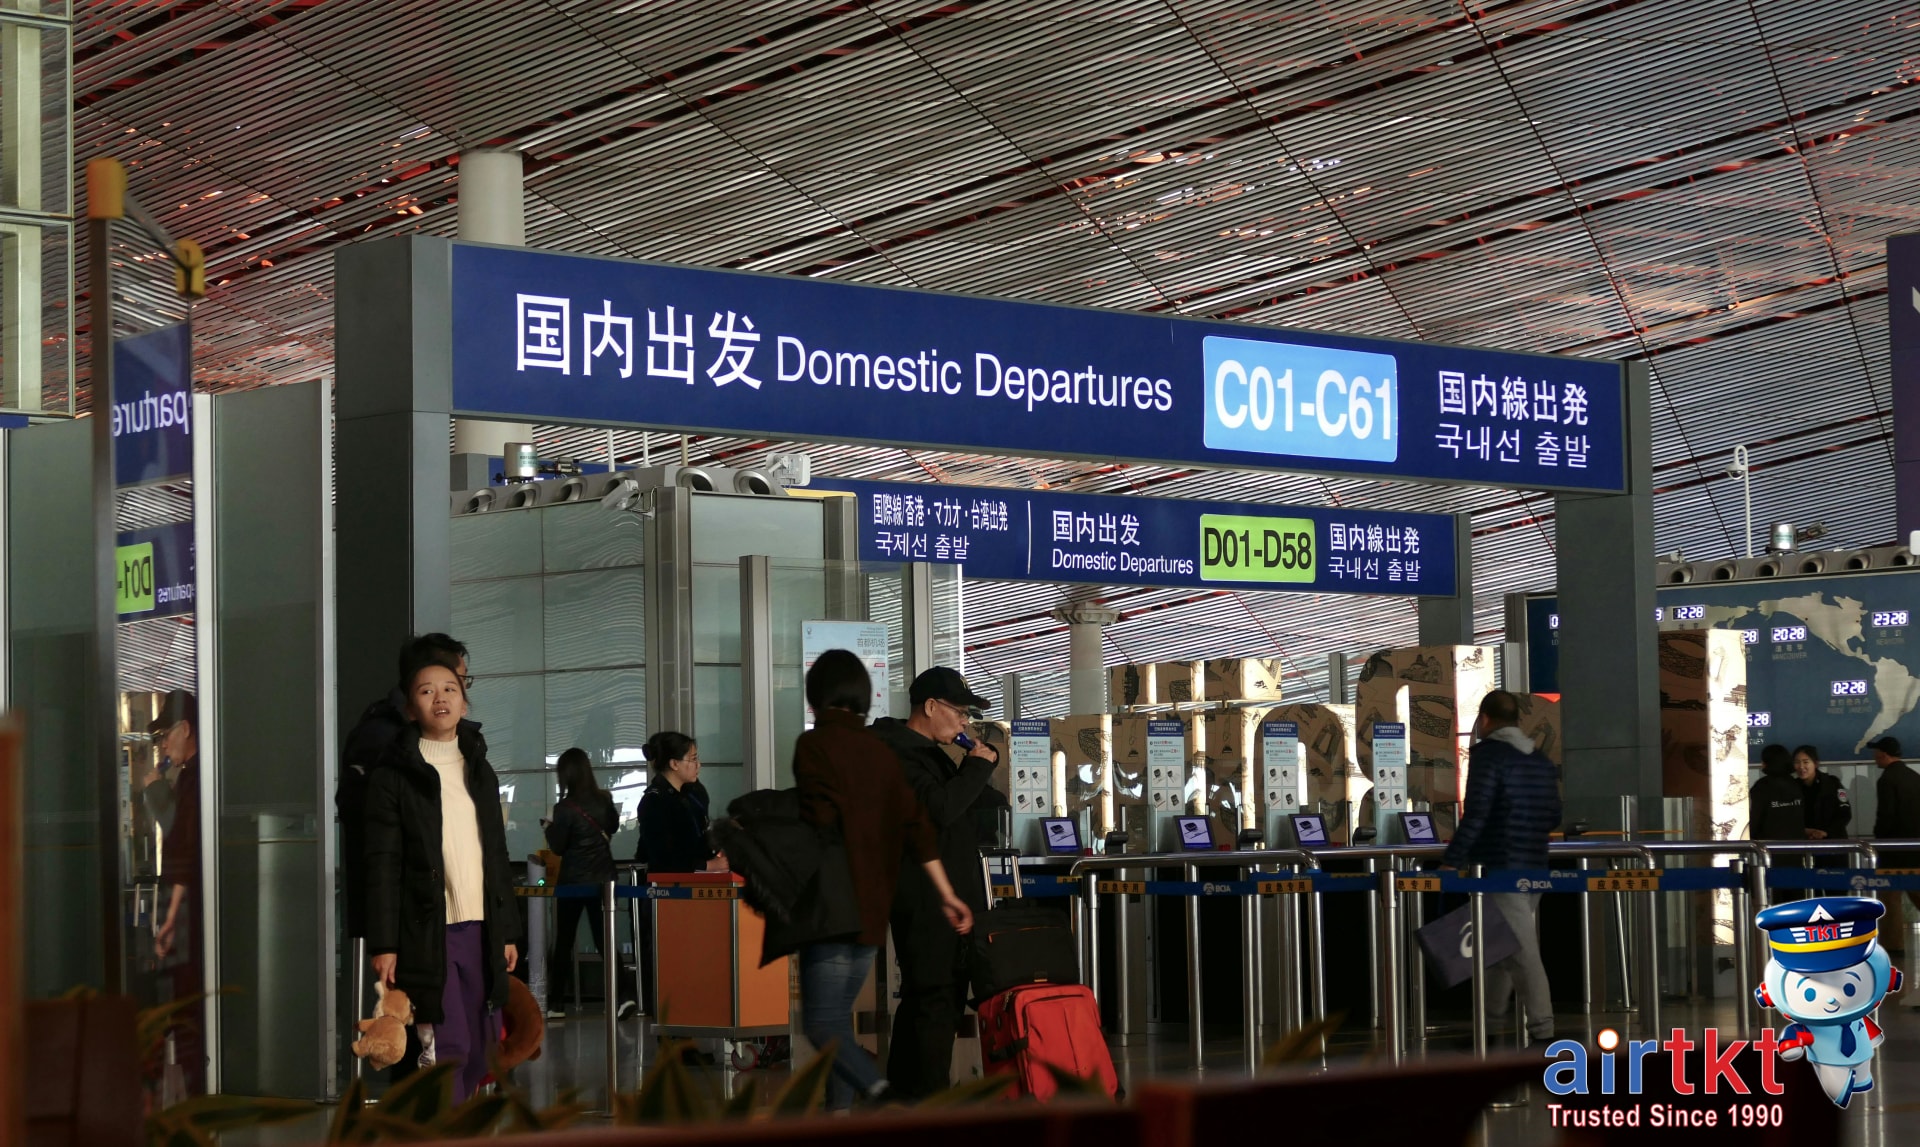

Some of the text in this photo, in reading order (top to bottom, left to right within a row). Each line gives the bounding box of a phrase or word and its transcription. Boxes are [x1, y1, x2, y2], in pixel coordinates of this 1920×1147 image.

[515, 293, 763, 390] 国内出发
[777, 335, 1174, 412] Domestic Departures
[1214, 358, 1392, 441] C01-C61
[1437, 370, 1590, 426] 国内線出発
[1434, 422, 1591, 470] 국내선 출발
[1052, 510, 1141, 546] 国内出发
[1329, 522, 1421, 555] 国内線出発
[875, 531, 970, 559] 국제선 출발
[1204, 527, 1312, 570] D01-D58
[1052, 548, 1194, 576] Domestic Departures
[1328, 557, 1421, 582] 국내선 출발
[1675, 606, 1704, 620] 1228
[1873, 612, 1907, 626] 2328
[1743, 630, 1757, 643] 28
[1772, 627, 1805, 641] 2028
[1833, 681, 1866, 695] 0228
[1746, 713, 1769, 726] 528
[1532, 880, 1552, 889] BCIA
[1597, 879, 1650, 890] 应急专用
[1868, 878, 1891, 887] BCIA
